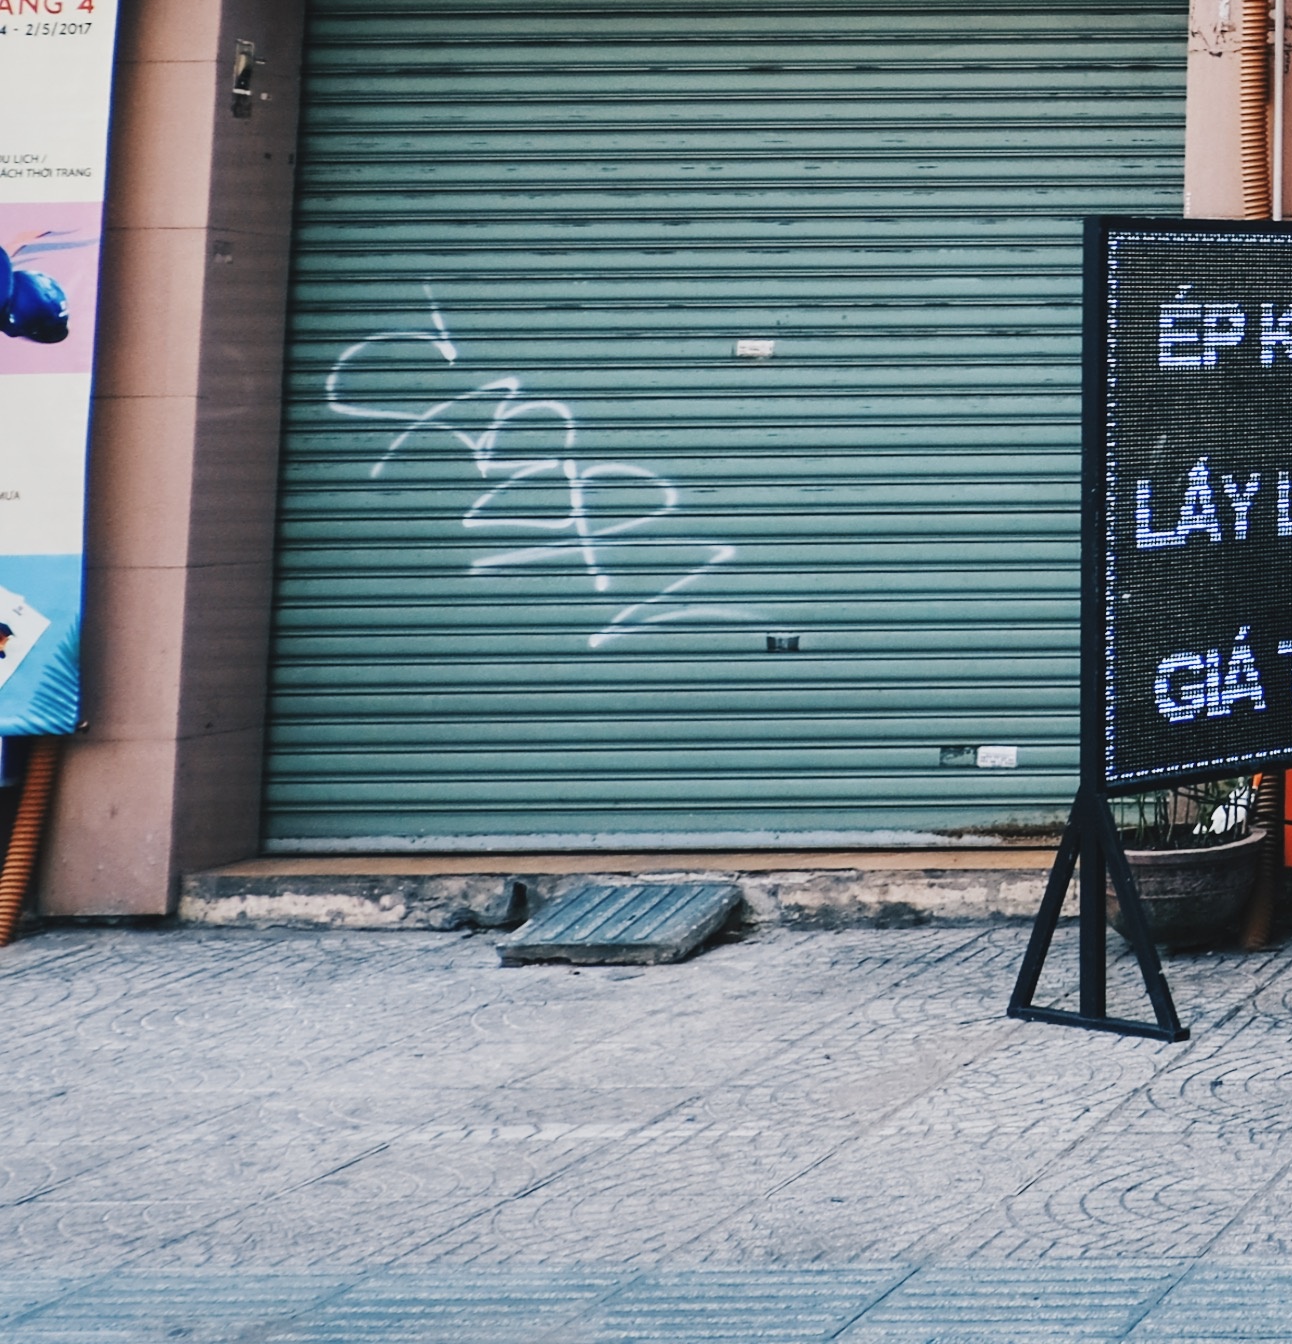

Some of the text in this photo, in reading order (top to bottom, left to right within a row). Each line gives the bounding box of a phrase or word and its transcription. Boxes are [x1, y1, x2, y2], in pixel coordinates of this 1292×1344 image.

[25, 22, 92, 36] 2/5/2017
[1158, 283, 1247, 370] ÉP
[1153, 625, 1267, 723] GIÁ
